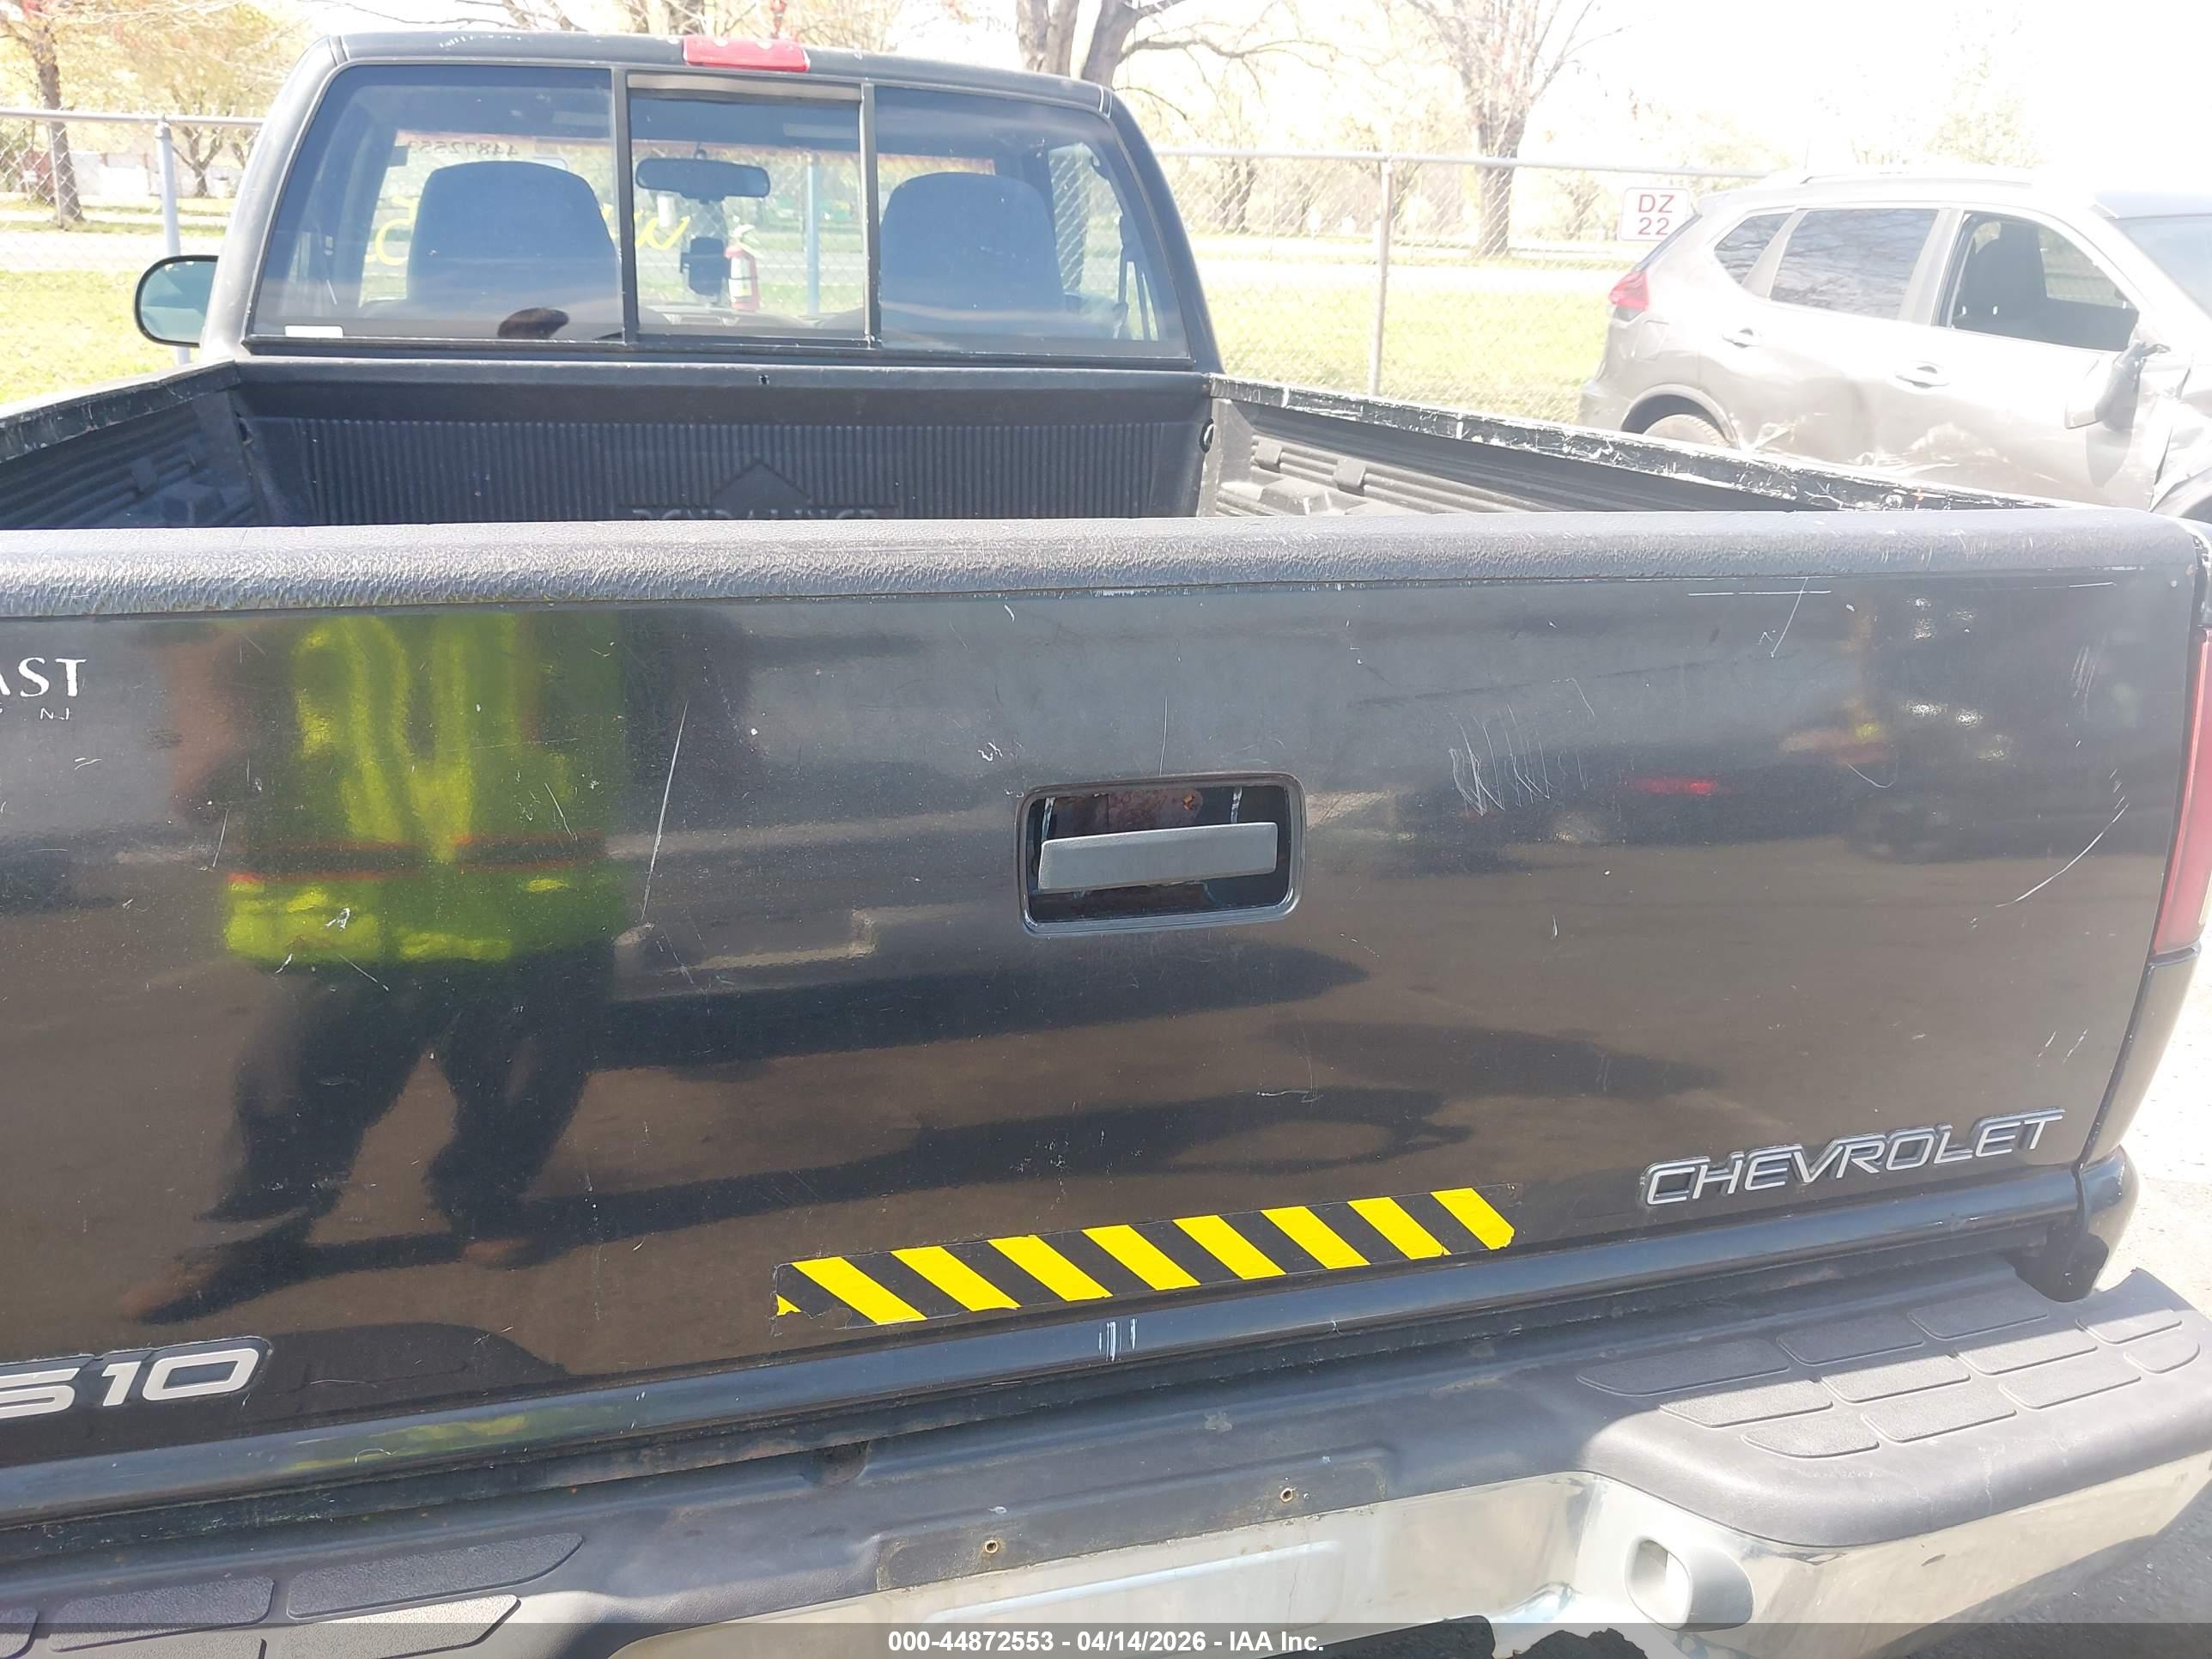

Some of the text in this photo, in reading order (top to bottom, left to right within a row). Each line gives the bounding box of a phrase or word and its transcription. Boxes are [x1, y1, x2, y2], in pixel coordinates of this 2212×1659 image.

[1638, 194, 1675, 214] DZ
[1638, 216, 1670, 235] 22
[1643, 1108, 2064, 1206] CHEVROLET
